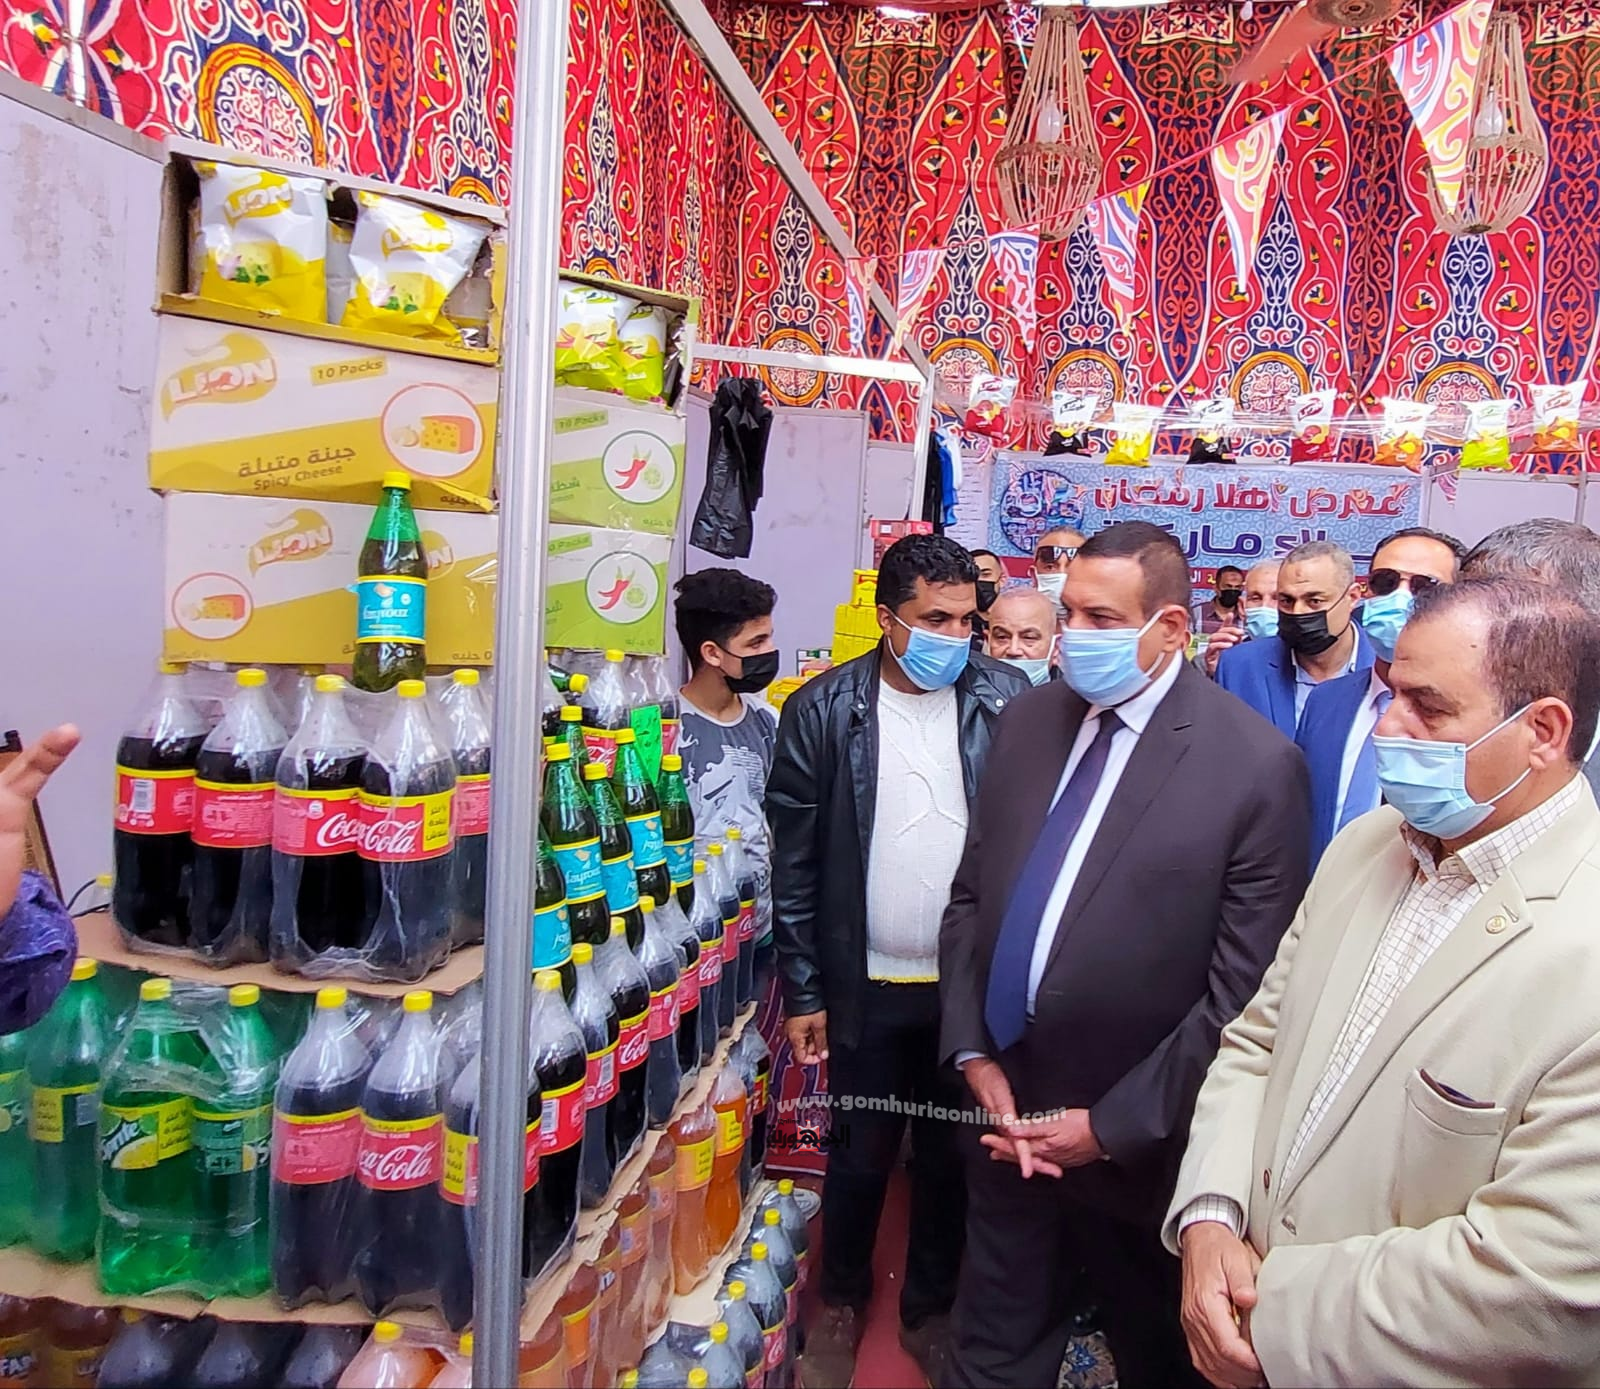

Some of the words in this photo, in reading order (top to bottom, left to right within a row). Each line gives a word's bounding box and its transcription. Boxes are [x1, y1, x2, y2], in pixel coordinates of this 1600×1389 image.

[225, 184, 292, 217] LION
[169, 358, 276, 403] LION
[317, 366, 335, 380] 10
[339, 358, 384, 375] Packs
[239, 455, 300, 479] متبلة
[308, 446, 357, 467] جبنة
[254, 475, 291, 490] Spicy
[295, 464, 345, 482] Cheese
[1094, 477, 1205, 513] رمضان
[254, 526, 332, 565] LION
